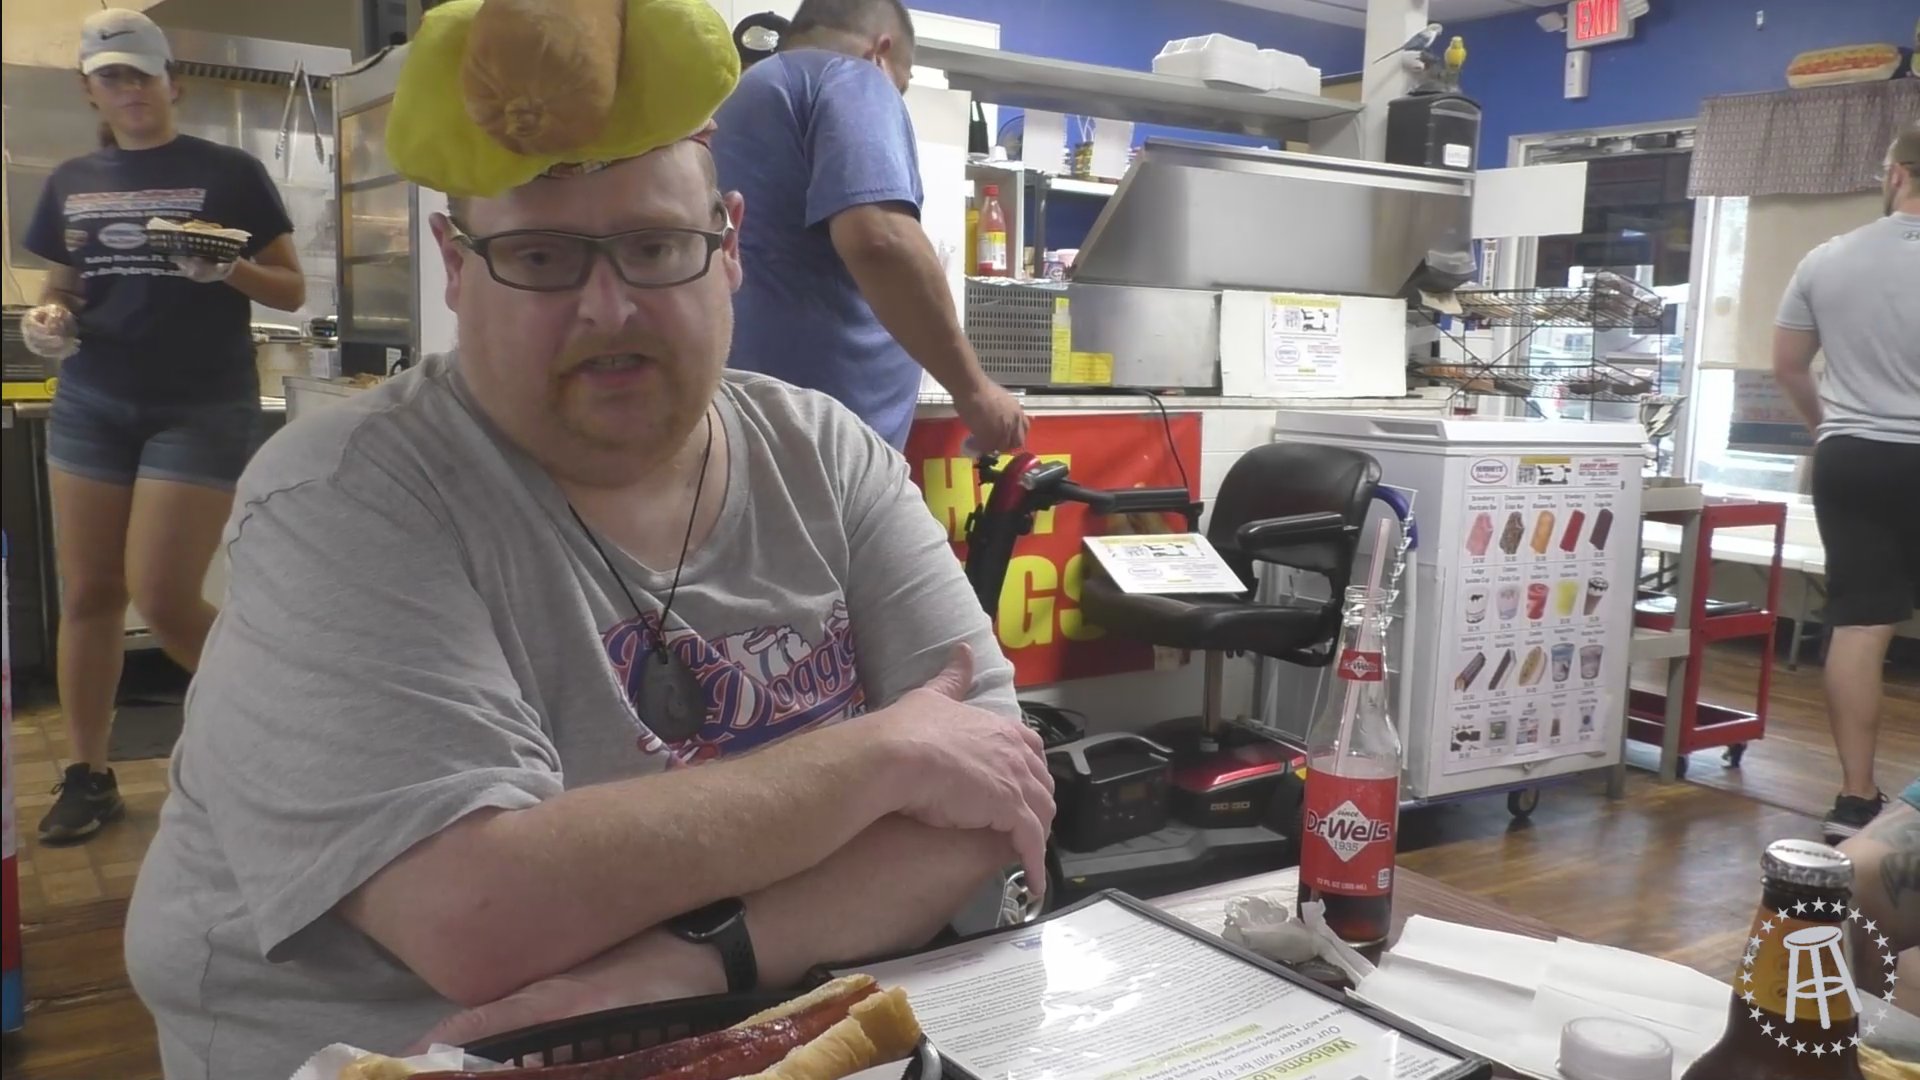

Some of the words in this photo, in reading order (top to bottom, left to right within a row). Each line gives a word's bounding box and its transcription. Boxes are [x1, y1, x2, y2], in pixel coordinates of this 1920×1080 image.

[1577, 0, 1619, 40] EXIT
[1334, 840, 1359, 852] 1935
[1317, 1025, 1341, 1039] Our
[1279, 1036, 1316, 1055] server
[1254, 1053, 1278, 1066] will
[1274, 1039, 1357, 1074] Welcome
